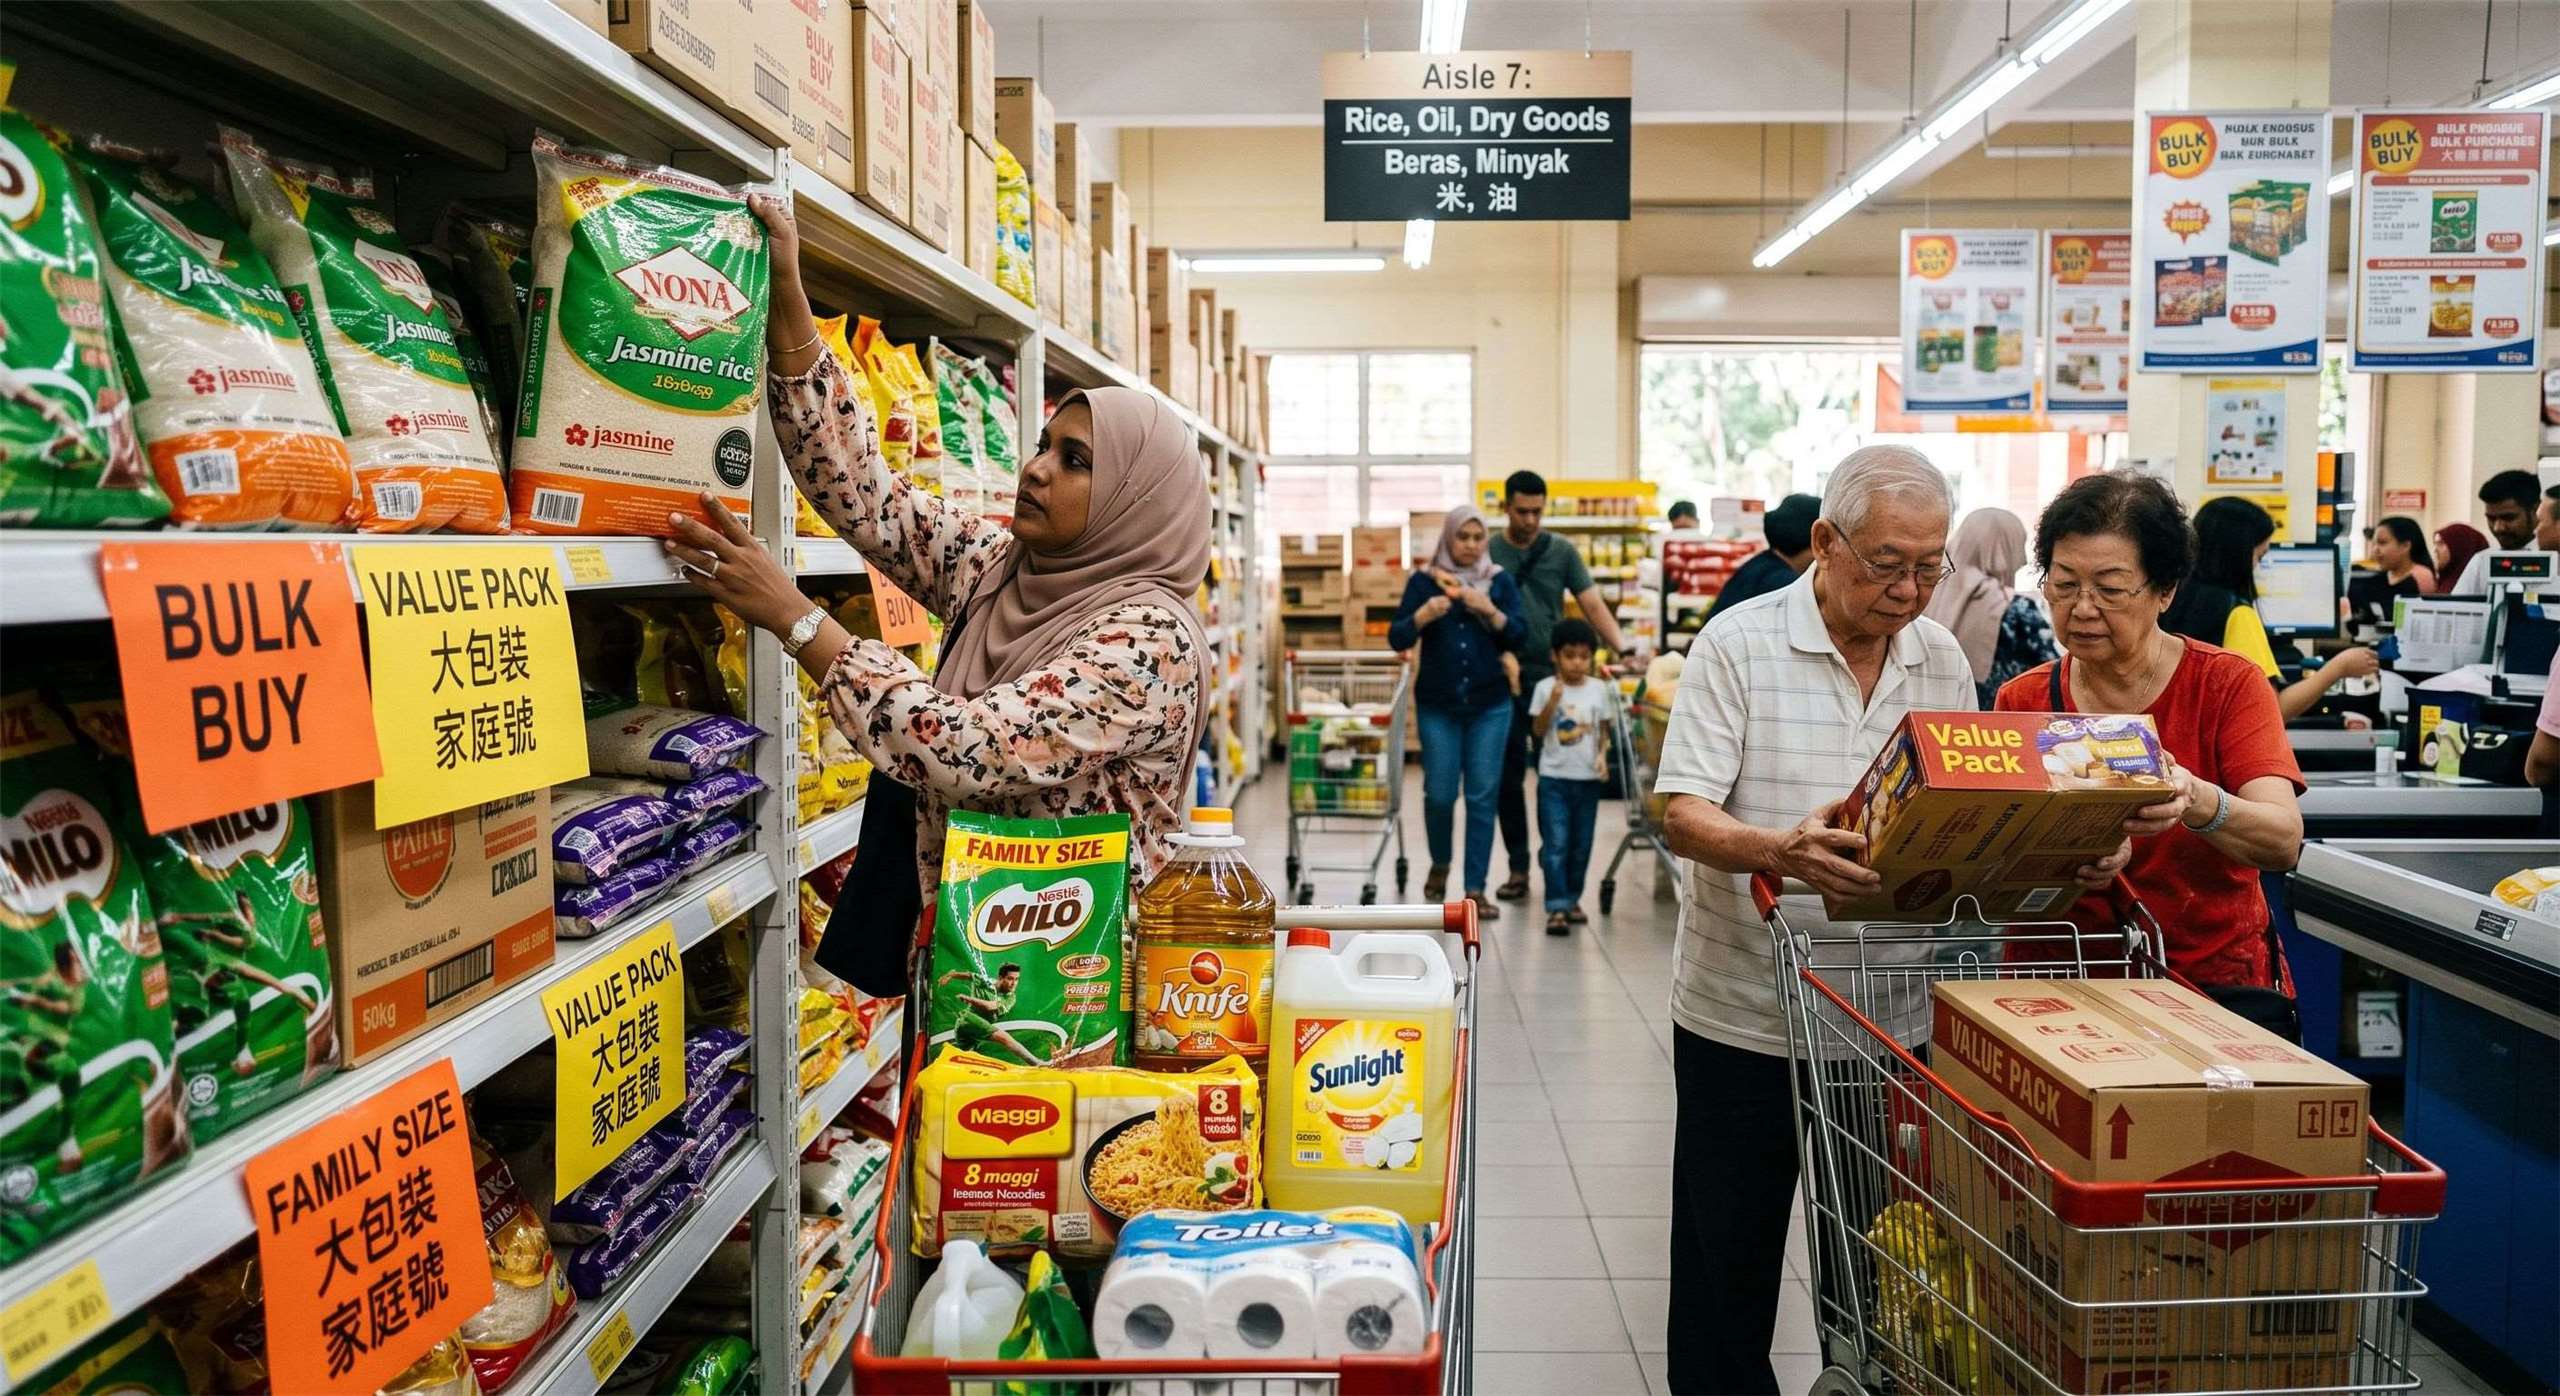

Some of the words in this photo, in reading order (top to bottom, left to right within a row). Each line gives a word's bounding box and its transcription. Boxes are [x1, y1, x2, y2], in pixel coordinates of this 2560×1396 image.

[806, 25, 834, 67] BULK
[810, 56, 833, 90] BUY
[1423, 64, 1495, 89] Aisle
[1506, 64, 1531, 89] 7:
[1345, 106, 1410, 136] Rice,
[1417, 106, 1462, 136] Oil,
[1470, 106, 1516, 138] Dry
[1522, 105, 1610, 132] Goods
[2437, 123, 2466, 134] BULK
[2159, 131, 2208, 151] BULK
[2371, 130, 2419, 149] BULK
[2431, 136, 2461, 147] BULK
[1385, 148, 1468, 177] Beras,
[1476, 148, 1569, 179] Minyak
[2166, 150, 2204, 168] BUY
[2377, 147, 2414, 165] BUY
[1487, 182, 1517, 212] 油
[640, 268, 733, 312] NONA
[385, 314, 453, 346] Jasmine
[606, 335, 713, 374] Jasmine
[718, 359, 755, 382] rice
[219, 366, 295, 392] jasmine
[413, 410, 469, 434] jasmine
[591, 425, 675, 451] jasmine
[369, 570, 478, 618] VALUE
[486, 566, 559, 610] PACK
[155, 579, 321, 662] BULK
[430, 625, 531, 694] 大包裝
[191, 673, 308, 762] BUY
[432, 695, 537, 770] 家庭號
[1927, 721, 2024, 749] Value
[1941, 749, 2026, 775] Pack
[2, 823, 103, 889] MILO
[966, 837, 1050, 864] FAMILY
[1056, 839, 1104, 863] SIZE
[1037, 886, 1080, 903] Nestlé
[985, 899, 1082, 934] MILO
[555, 973, 630, 1040] VALUE
[627, 942, 676, 998] PACK
[1156, 982, 1249, 1020] Knife
[362, 1002, 397, 1033] 50kg
[592, 1000, 660, 1088] 大包裝
[1310, 1049, 1404, 1093] Sunlight
[1951, 1014, 2003, 1082] VALUE
[2008, 1057, 2062, 1128] PACK
[592, 1055, 661, 1148] 家庭號
[970, 1106, 1047, 1126] Maggi
[1209, 1088, 1229, 1115] 8
[267, 1129, 386, 1236] FAMILY
[392, 1089, 457, 1158] SIZE
[964, 1164, 981, 1186] 8
[983, 1168, 1040, 1187] maggi
[315, 1167, 438, 1298] 大包裝
[1174, 1221, 1335, 1242] Toilet
[321, 1242, 450, 1380] 家庭號
